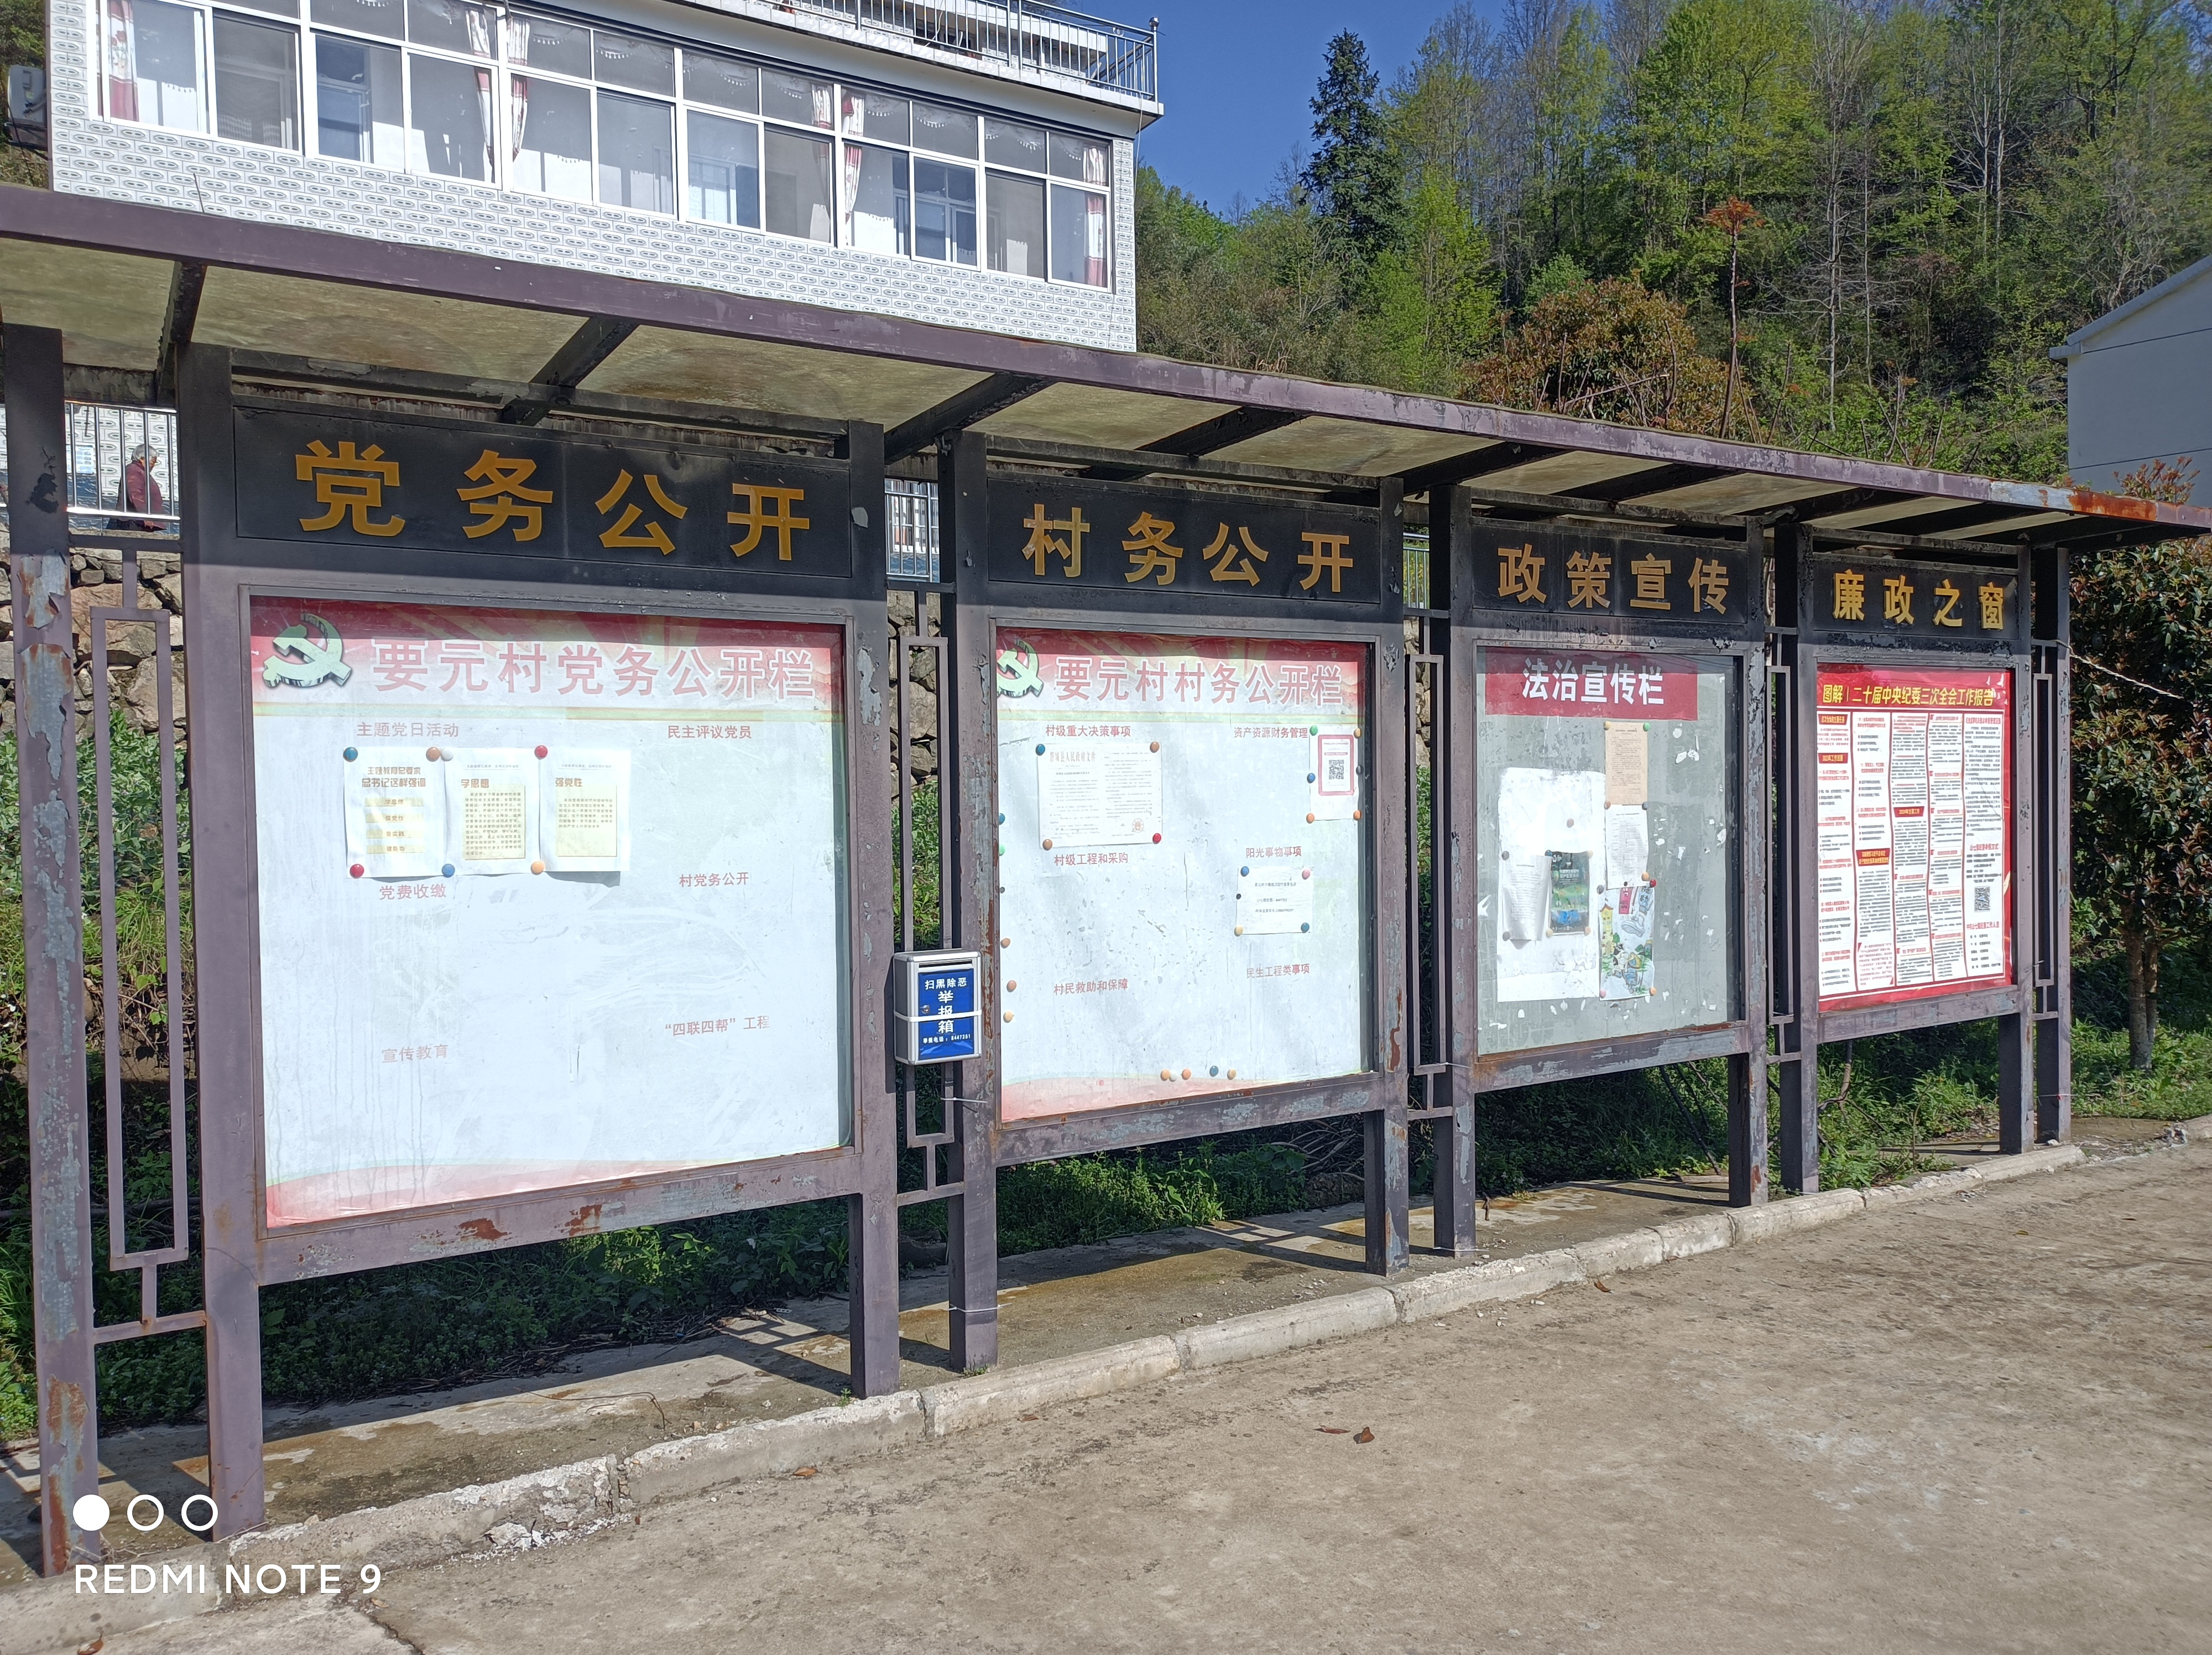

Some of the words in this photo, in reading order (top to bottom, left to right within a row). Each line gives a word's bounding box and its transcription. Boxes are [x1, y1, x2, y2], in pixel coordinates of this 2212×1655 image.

[295, 440, 810, 560] 党务公开
[1022, 503, 1353, 592] 村务公开
[1498, 543, 1729, 614] 政策宣传
[1833, 569, 2004, 630] 廉政之窗
[372, 638, 815, 700] 要元村党务公开栏
[1056, 656, 1342, 706] 要元村村务公开栏
[1522, 658, 1664, 705] 法治宣传栏
[357, 722, 459, 738] 主题党日活动
[667, 724, 752, 740] 民主评议党员
[1045, 725, 1130, 737] 村级重大决策事项
[1234, 726, 1308, 739] 资产资源财务管理
[367, 767, 421, 775] 主题教育总要求
[362, 778, 426, 788] 总书记这样强调
[461, 778, 489, 788] 学思想
[555, 777, 583, 787] 强党性
[1054, 852, 1128, 866] 村级工程和采购
[1245, 846, 1302, 858] 阳光事物事项
[679, 872, 750, 888] 村党务公开
[378, 884, 447, 901] 党费收缴
[1246, 963, 1310, 979] 民生工程类事项
[925, 977, 967, 990] 扫黑除恶
[1053, 978, 1128, 995] 村民救助和保障
[938, 990, 954, 1033] 举报箱
[381, 1043, 449, 1064] 宣传教育
